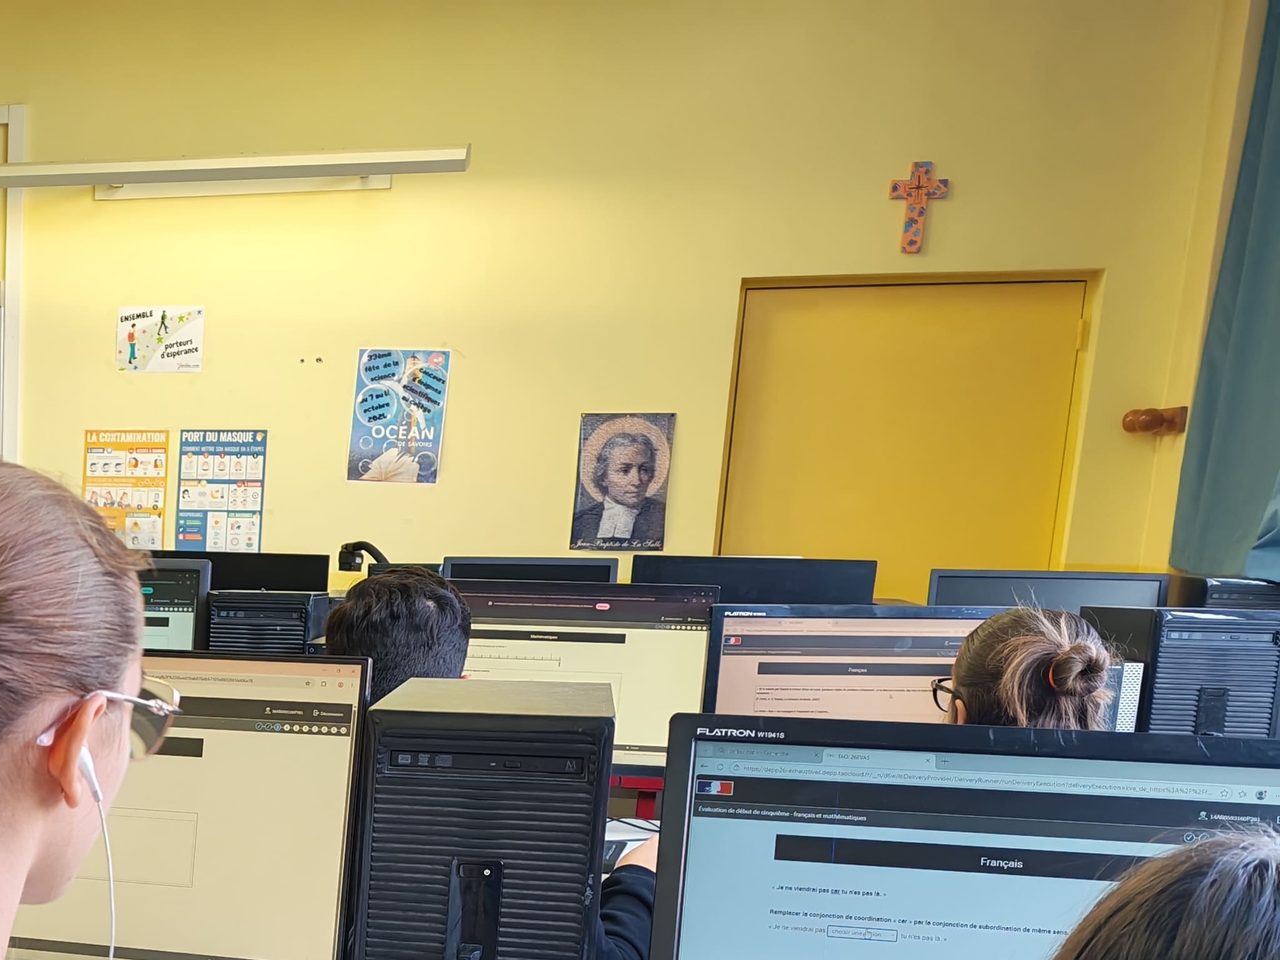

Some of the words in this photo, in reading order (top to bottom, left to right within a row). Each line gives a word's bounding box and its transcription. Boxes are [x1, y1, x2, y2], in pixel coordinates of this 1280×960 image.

[120, 309, 154, 323] ENSEMBLE
[164, 338, 193, 352] porteurs
[182, 431, 205, 442] PORT
[206, 431, 218, 442] DU
[220, 431, 254, 443] MASQUE
[371, 420, 435, 440] OCÉAN
[87, 432, 97, 443] LA
[99, 432, 166, 443] CONTAMINATION
[696, 727, 756, 739] FLATRON
[757, 731, 786, 740] W1941S
[698, 806, 728, 814] Évaluation
[736, 808, 752, 816] début
[760, 810, 790, 818] cinquième
[794, 811, 815, 820] français
[822, 812, 868, 822] mathématiques
[980, 856, 1024, 870] Français
[831, 888, 841, 896] car
[770, 908, 801, 918] Remplacer
[809, 911, 844, 920] conjonction
[854, 914, 892, 923] coordination
[932, 920, 968, 929] conjonction
[978, 924, 1022, 933] subordination
[1032, 926, 1052, 934] même
[790, 925, 814, 933] viendrai
